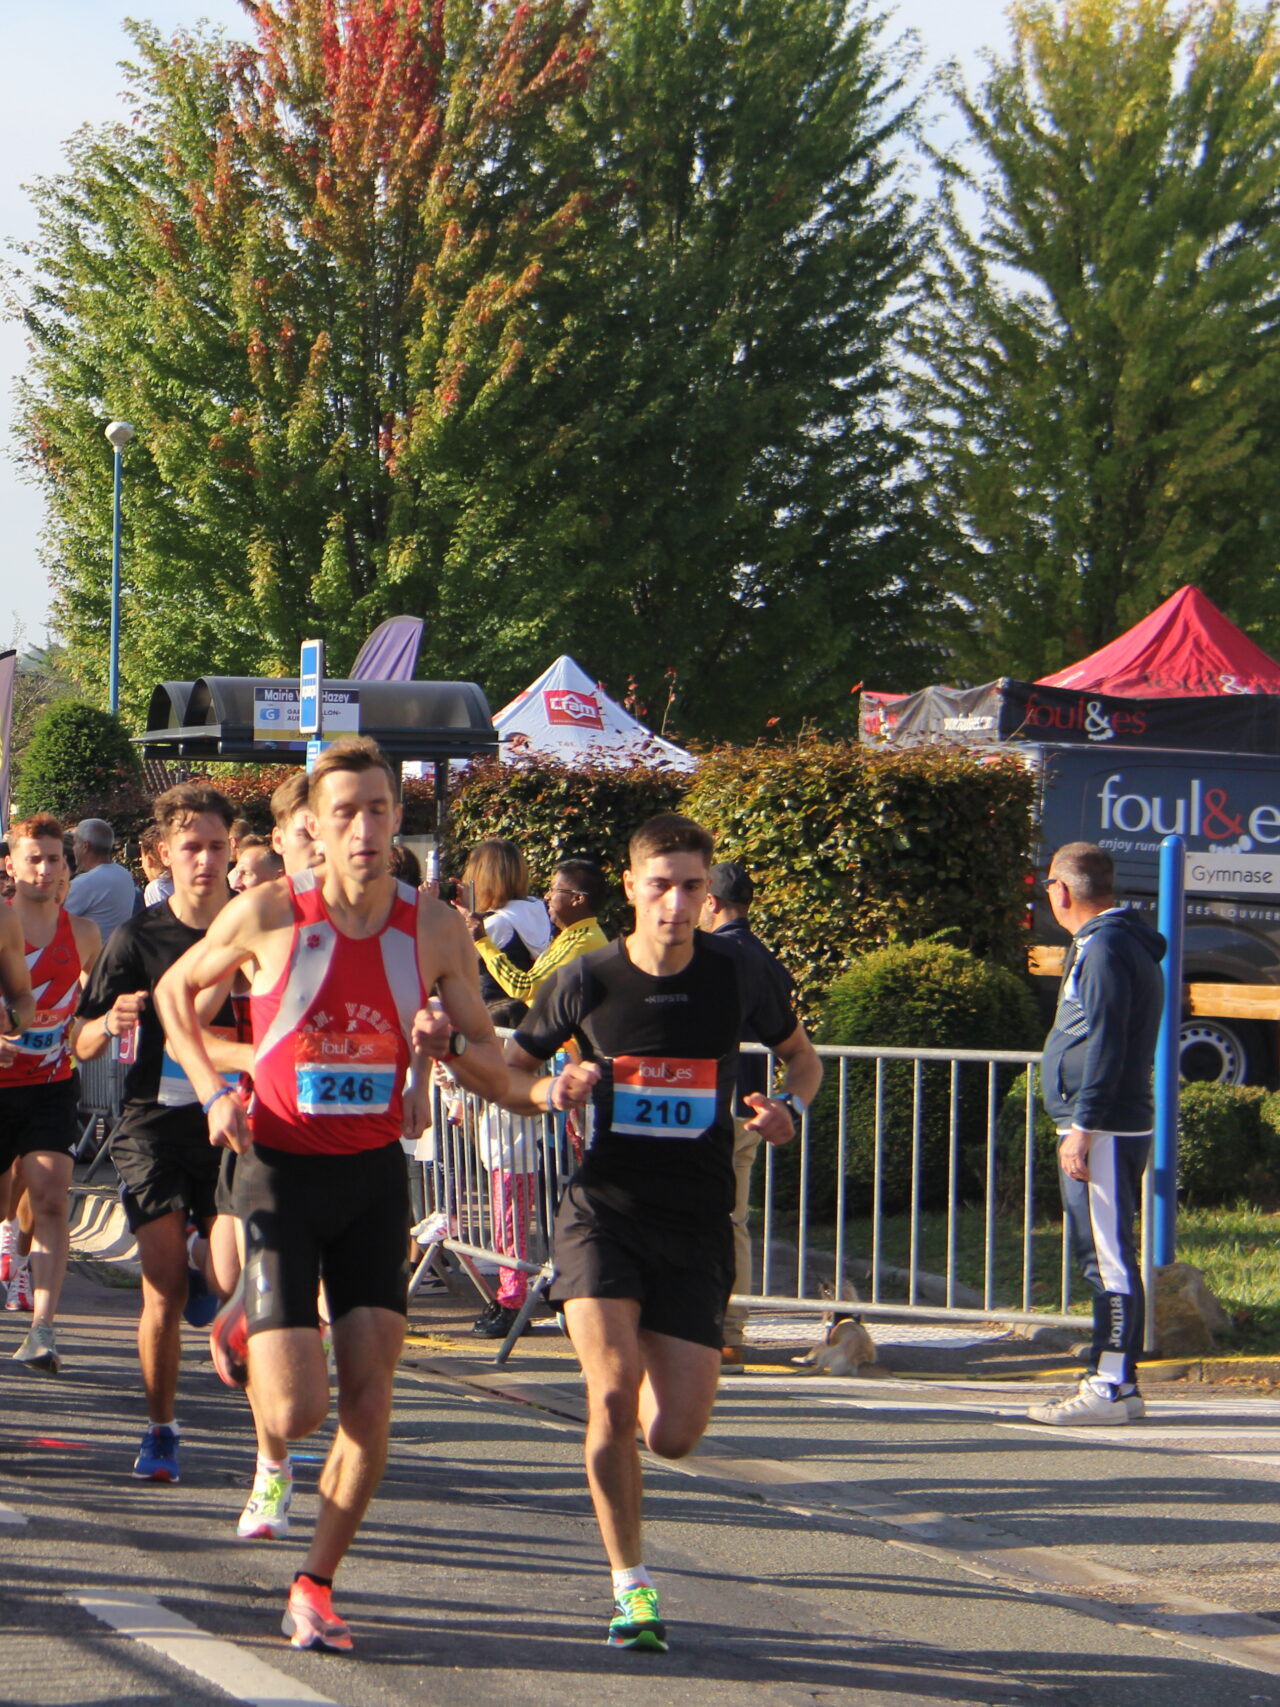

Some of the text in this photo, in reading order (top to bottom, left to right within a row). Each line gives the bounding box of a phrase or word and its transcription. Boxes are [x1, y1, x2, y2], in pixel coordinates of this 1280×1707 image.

[264, 689, 294, 701] Mairie
[1097, 775, 1280, 854] foul&e
[1191, 865, 1273, 884] Gymnase
[22, 1032, 54, 1048] 158
[319, 1076, 374, 1103] 246
[635, 1099, 692, 1125] 210
